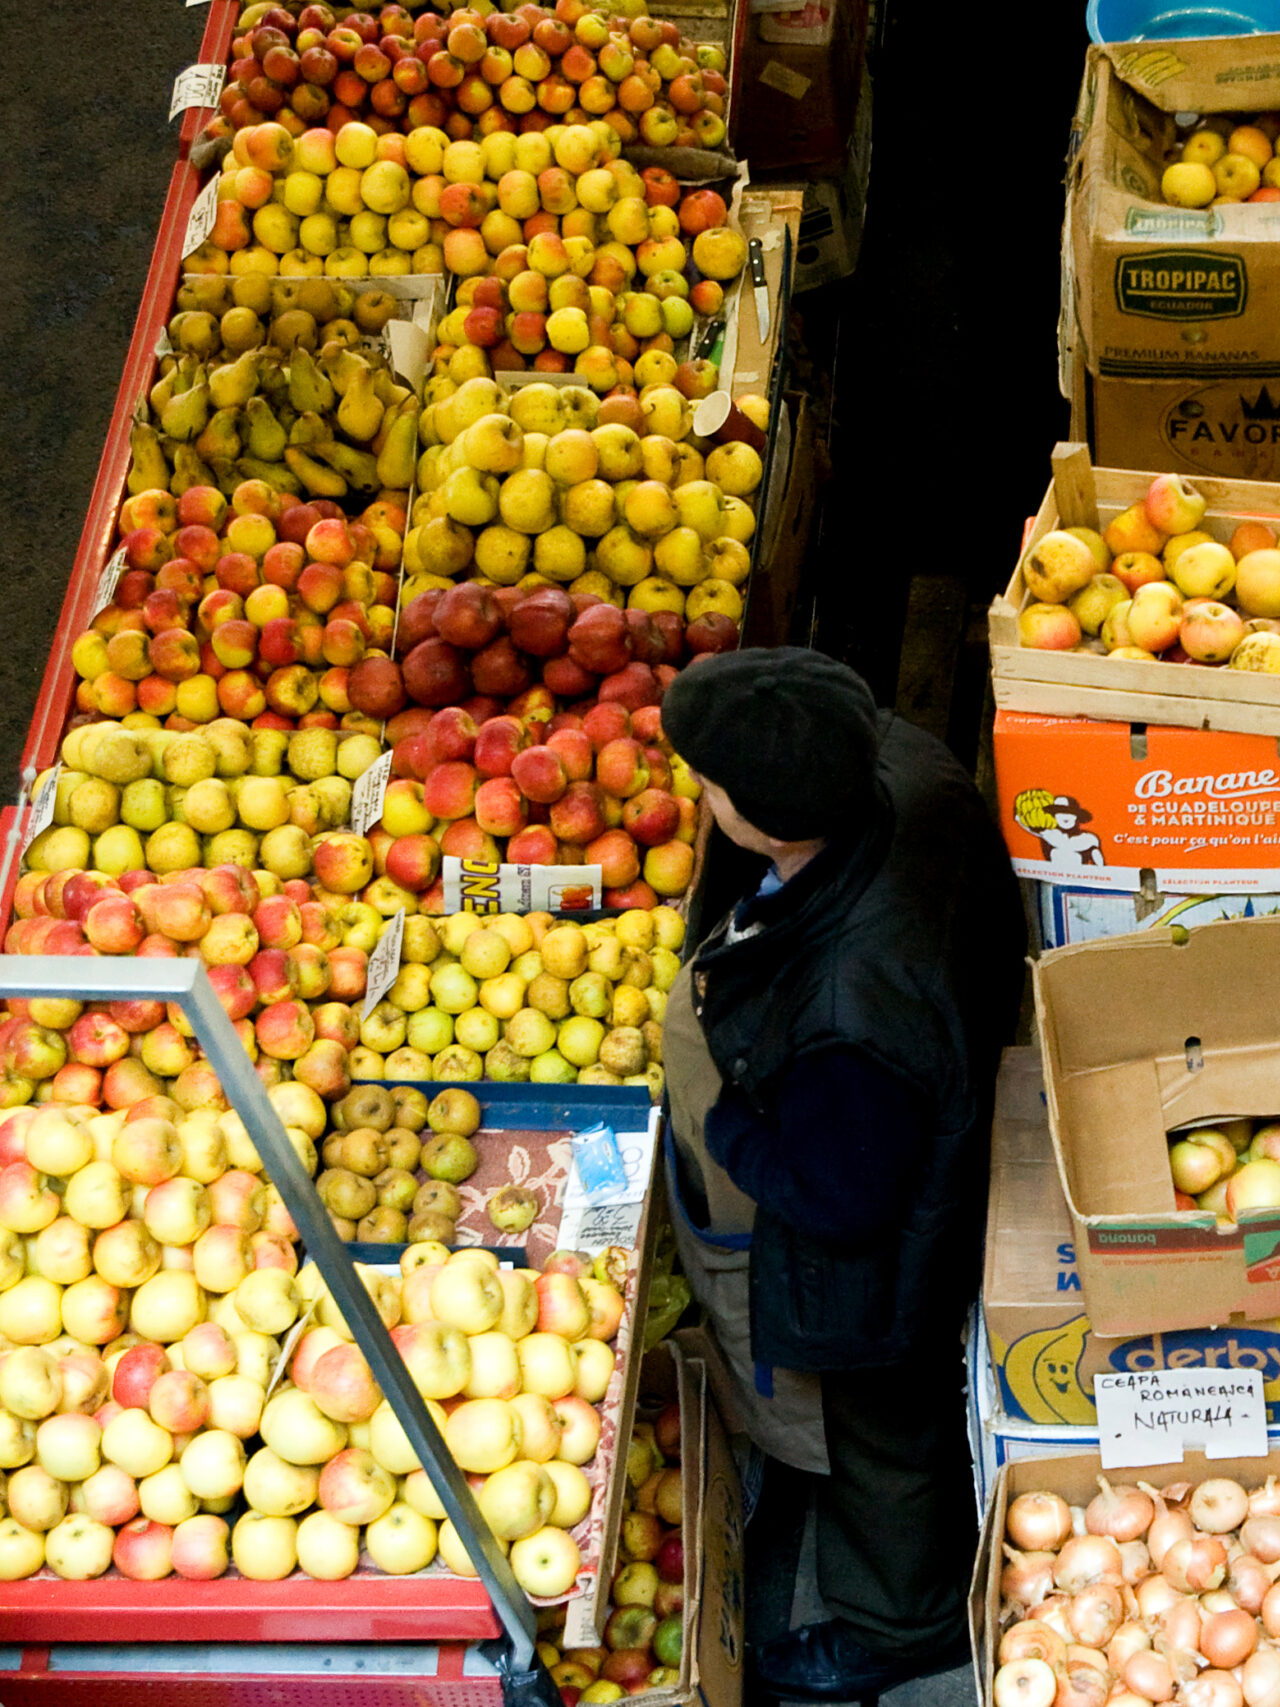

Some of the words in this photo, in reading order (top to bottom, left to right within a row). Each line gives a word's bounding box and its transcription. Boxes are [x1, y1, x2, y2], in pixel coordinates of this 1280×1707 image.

[1134, 216, 1213, 231] TROPIPA
[1128, 268, 1236, 291] TROPIPAC
[1103, 346, 1180, 360] PREMIUM
[1184, 349, 1259, 361] BANANAS
[1127, 803, 1147, 813] DE
[1134, 814, 1146, 826] &
[1151, 813, 1276, 826] MARTINIQUE
[1113, 832, 1150, 844] C'est
[1151, 836, 1187, 847] pour
[1184, 837, 1209, 853] ça
[1209, 833, 1251, 847] qu'on
[1099, 1232, 1157, 1247] banana
